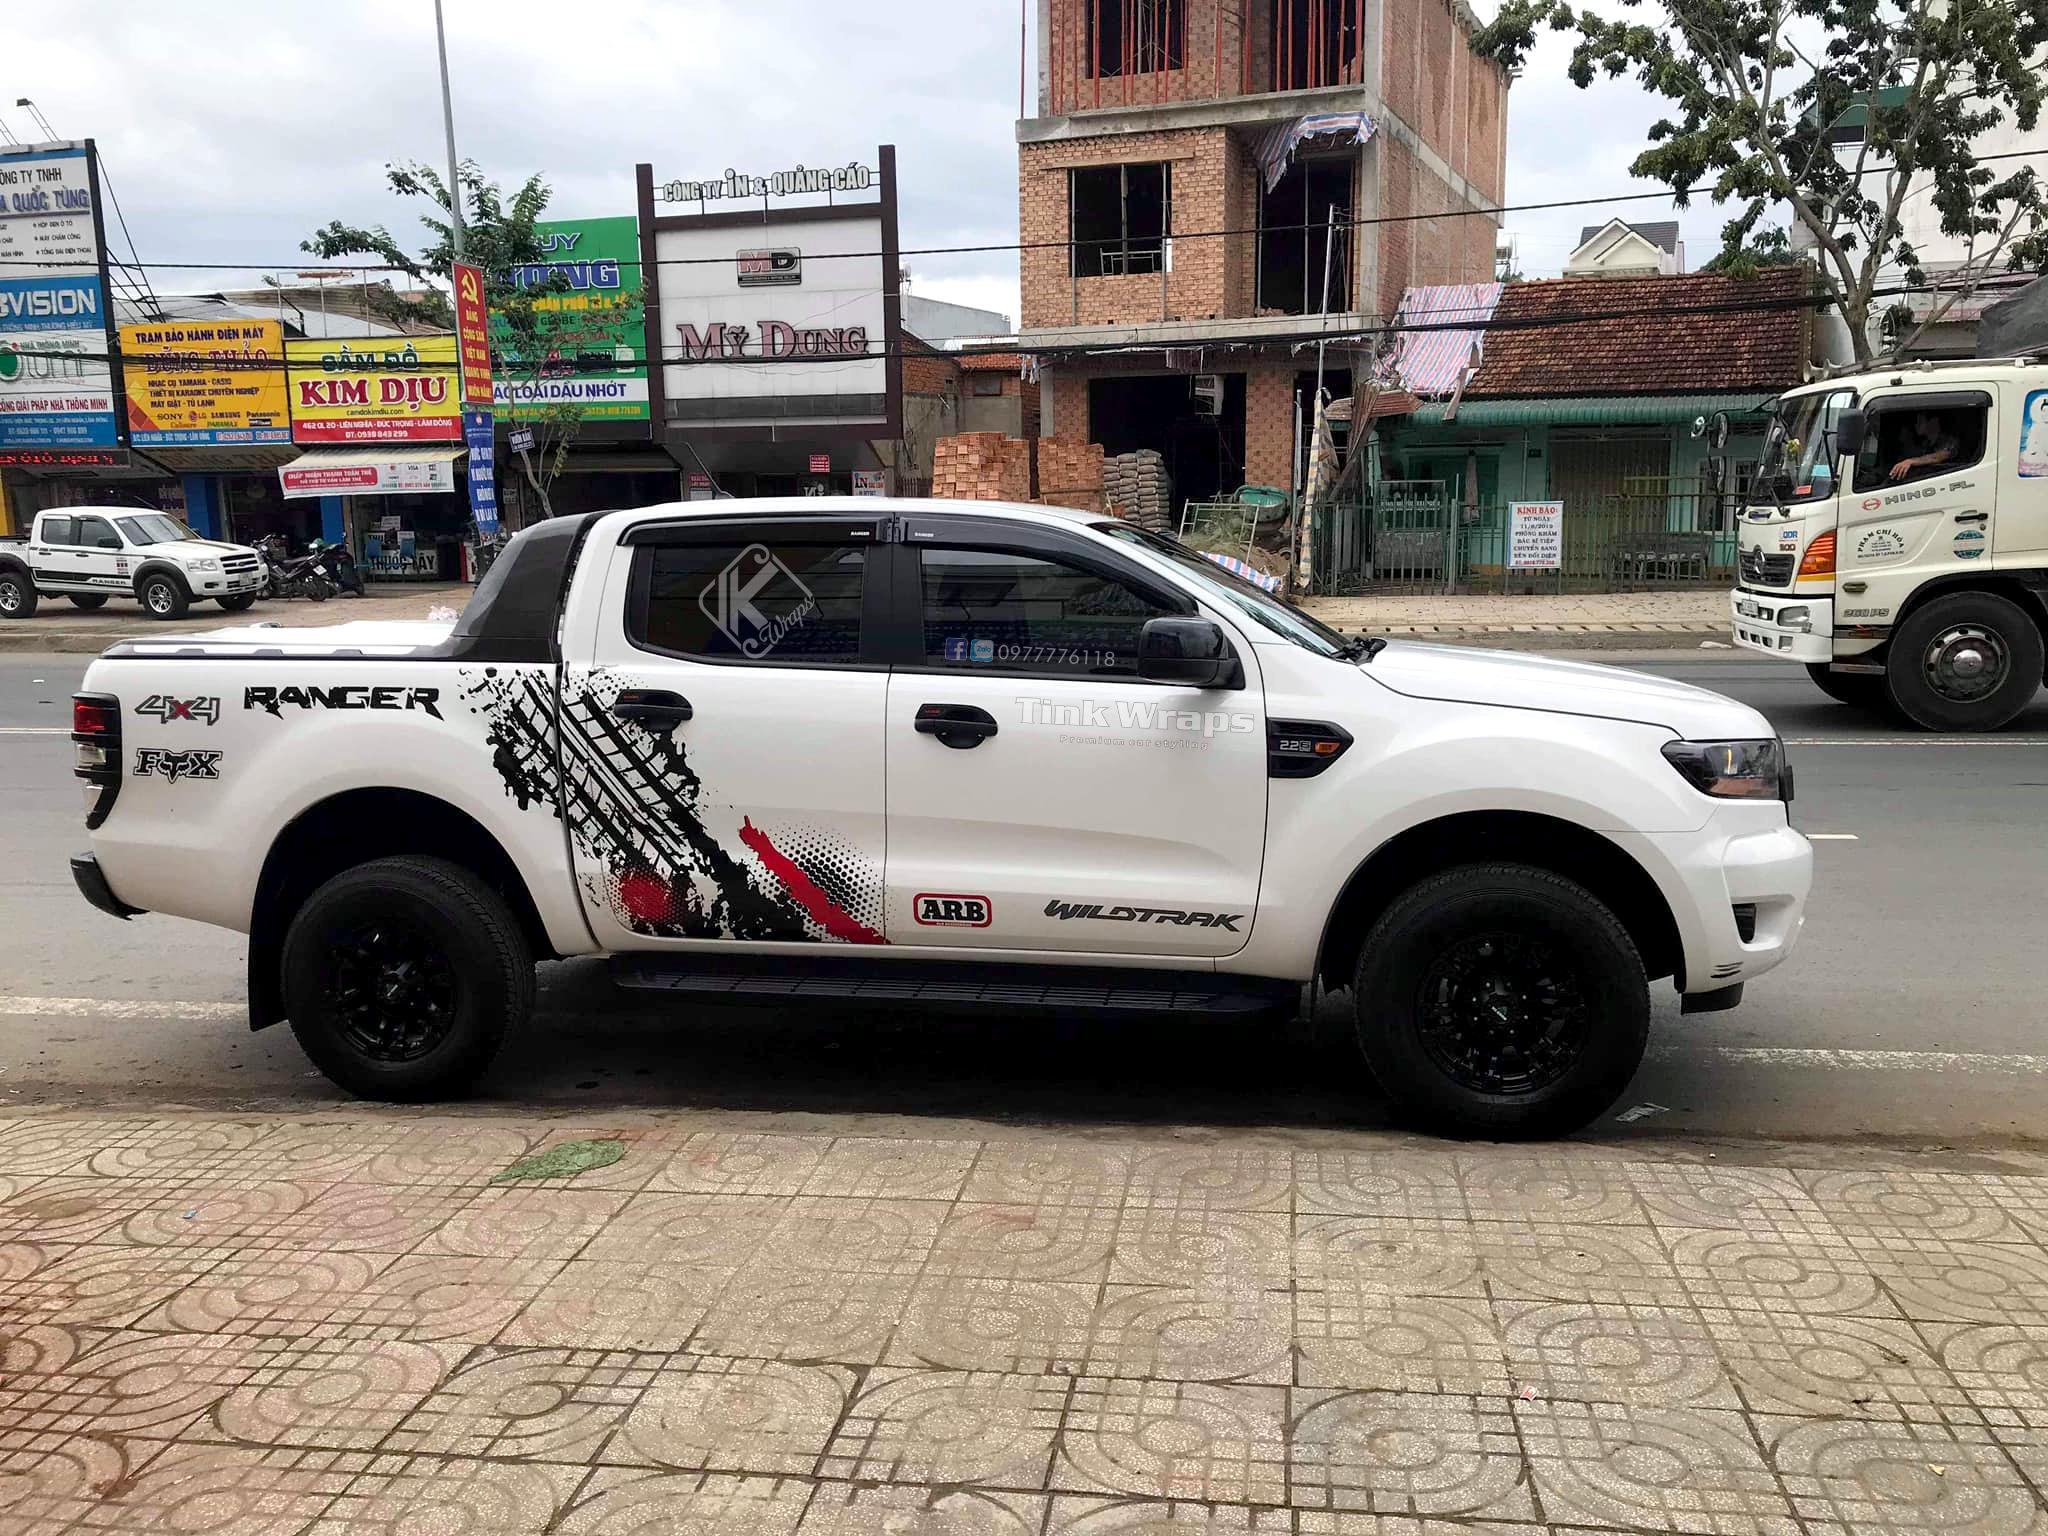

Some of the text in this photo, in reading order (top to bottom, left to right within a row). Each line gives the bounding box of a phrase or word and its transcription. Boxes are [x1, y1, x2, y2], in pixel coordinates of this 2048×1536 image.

[20, 169, 32, 183] TY
[36, 167, 62, 182] TNHH
[663, 179, 700, 202] CÔNG
[702, 180, 723, 200] TY
[753, 177, 768, 197] &
[771, 164, 831, 197] QUẢNG
[832, 161, 870, 191] CÁO
[12, 185, 49, 212] QUỐC
[52, 185, 90, 208] TÙNG
[740, 250, 797, 273] MD
[135, 324, 264, 345] TRẠM BẢO HÀNH ĐIỆN MÁY
[676, 320, 869, 359] MỸ DUNG
[211, 378, 232, 386] CASIO
[298, 376, 447, 411] KIM DỊU
[551, 380, 583, 398] DẦU
[586, 379, 627, 398] NHỚT
[31, 397, 48, 411] PHÁP
[66, 395, 88, 410] THÔNG
[90, 398, 108, 410] MINH
[211, 411, 241, 419] SAMSUNG
[246, 410, 281, 418] Panasonic
[327, 421, 336, 429] 20
[1884, 480, 1975, 505] HINO FL
[1517, 504, 1537, 514] KÍNH
[759, 597, 815, 645] Wraps
[977, 645, 991, 653] Zalo
[998, 644, 1116, 667] 0977776118
[244, 686, 445, 721] RANGER
[1015, 696, 1256, 738] Tink Wraps
[1060, 734, 1125, 746] Premium
[1155, 739, 1209, 751] styling
[921, 899, 986, 922] ARB
[1043, 899, 1246, 933] WILDTRAK
